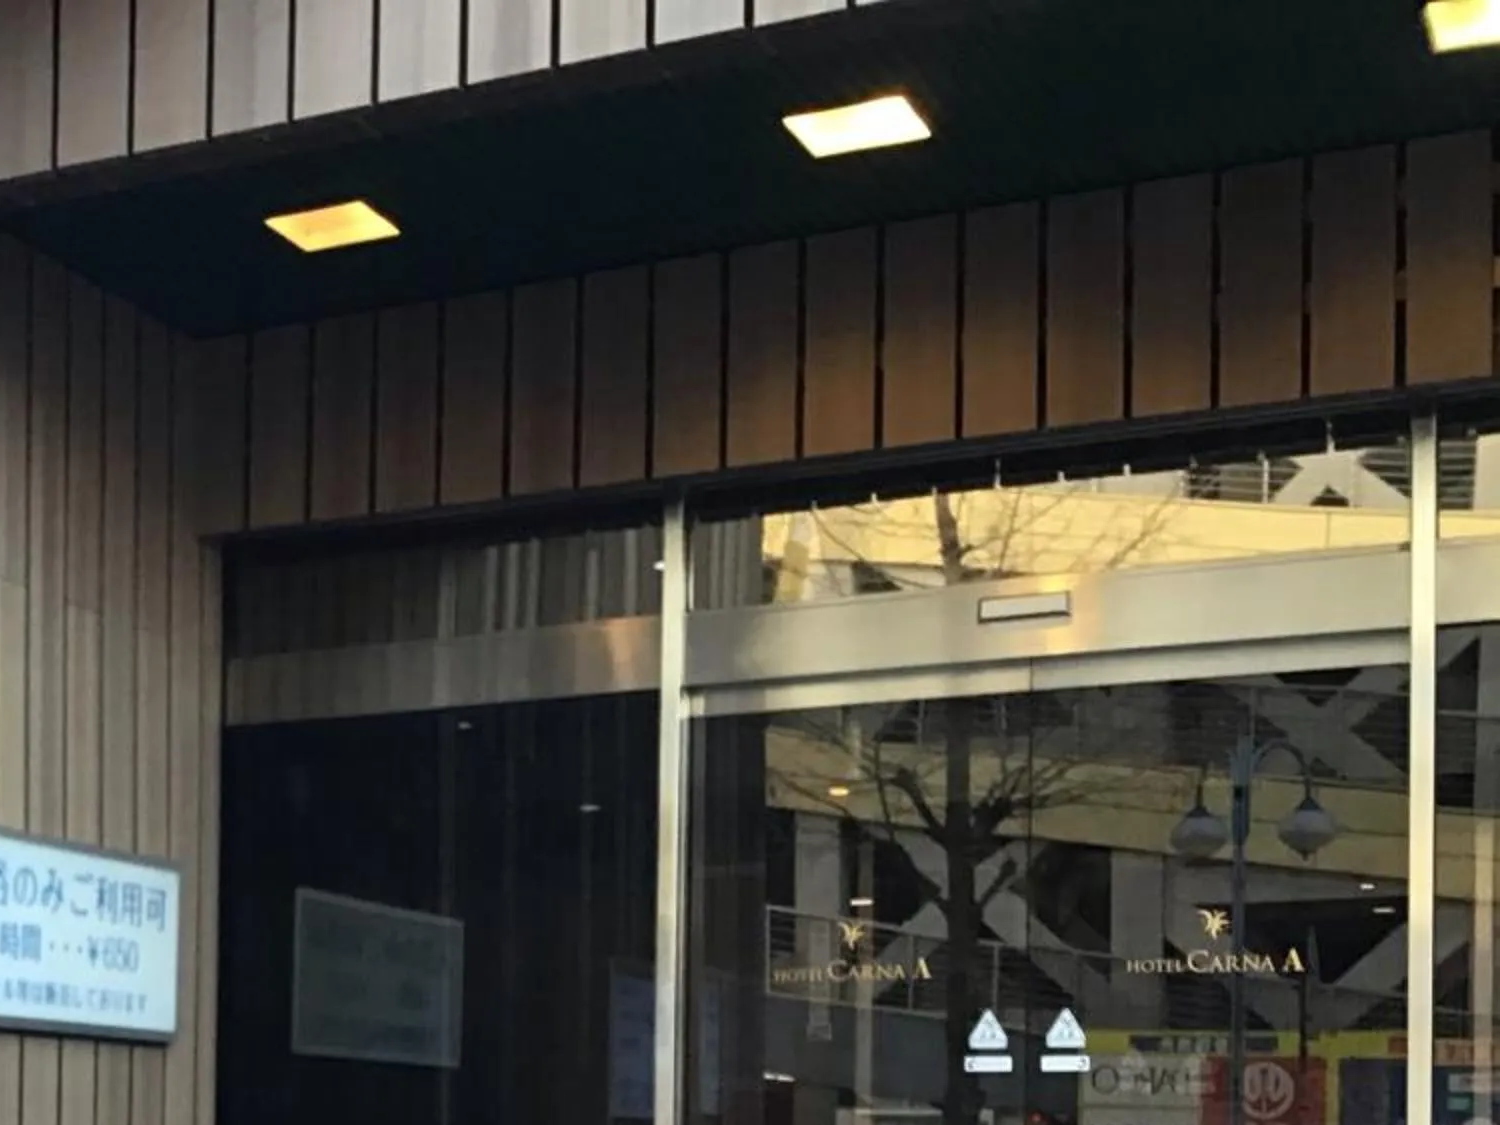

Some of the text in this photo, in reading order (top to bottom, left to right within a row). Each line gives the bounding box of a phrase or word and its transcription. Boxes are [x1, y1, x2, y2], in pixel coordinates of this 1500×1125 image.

[826, 959, 906, 984] CARNA
[912, 956, 932, 980] A
[1126, 947, 1306, 974] HOTEL CARNA A
